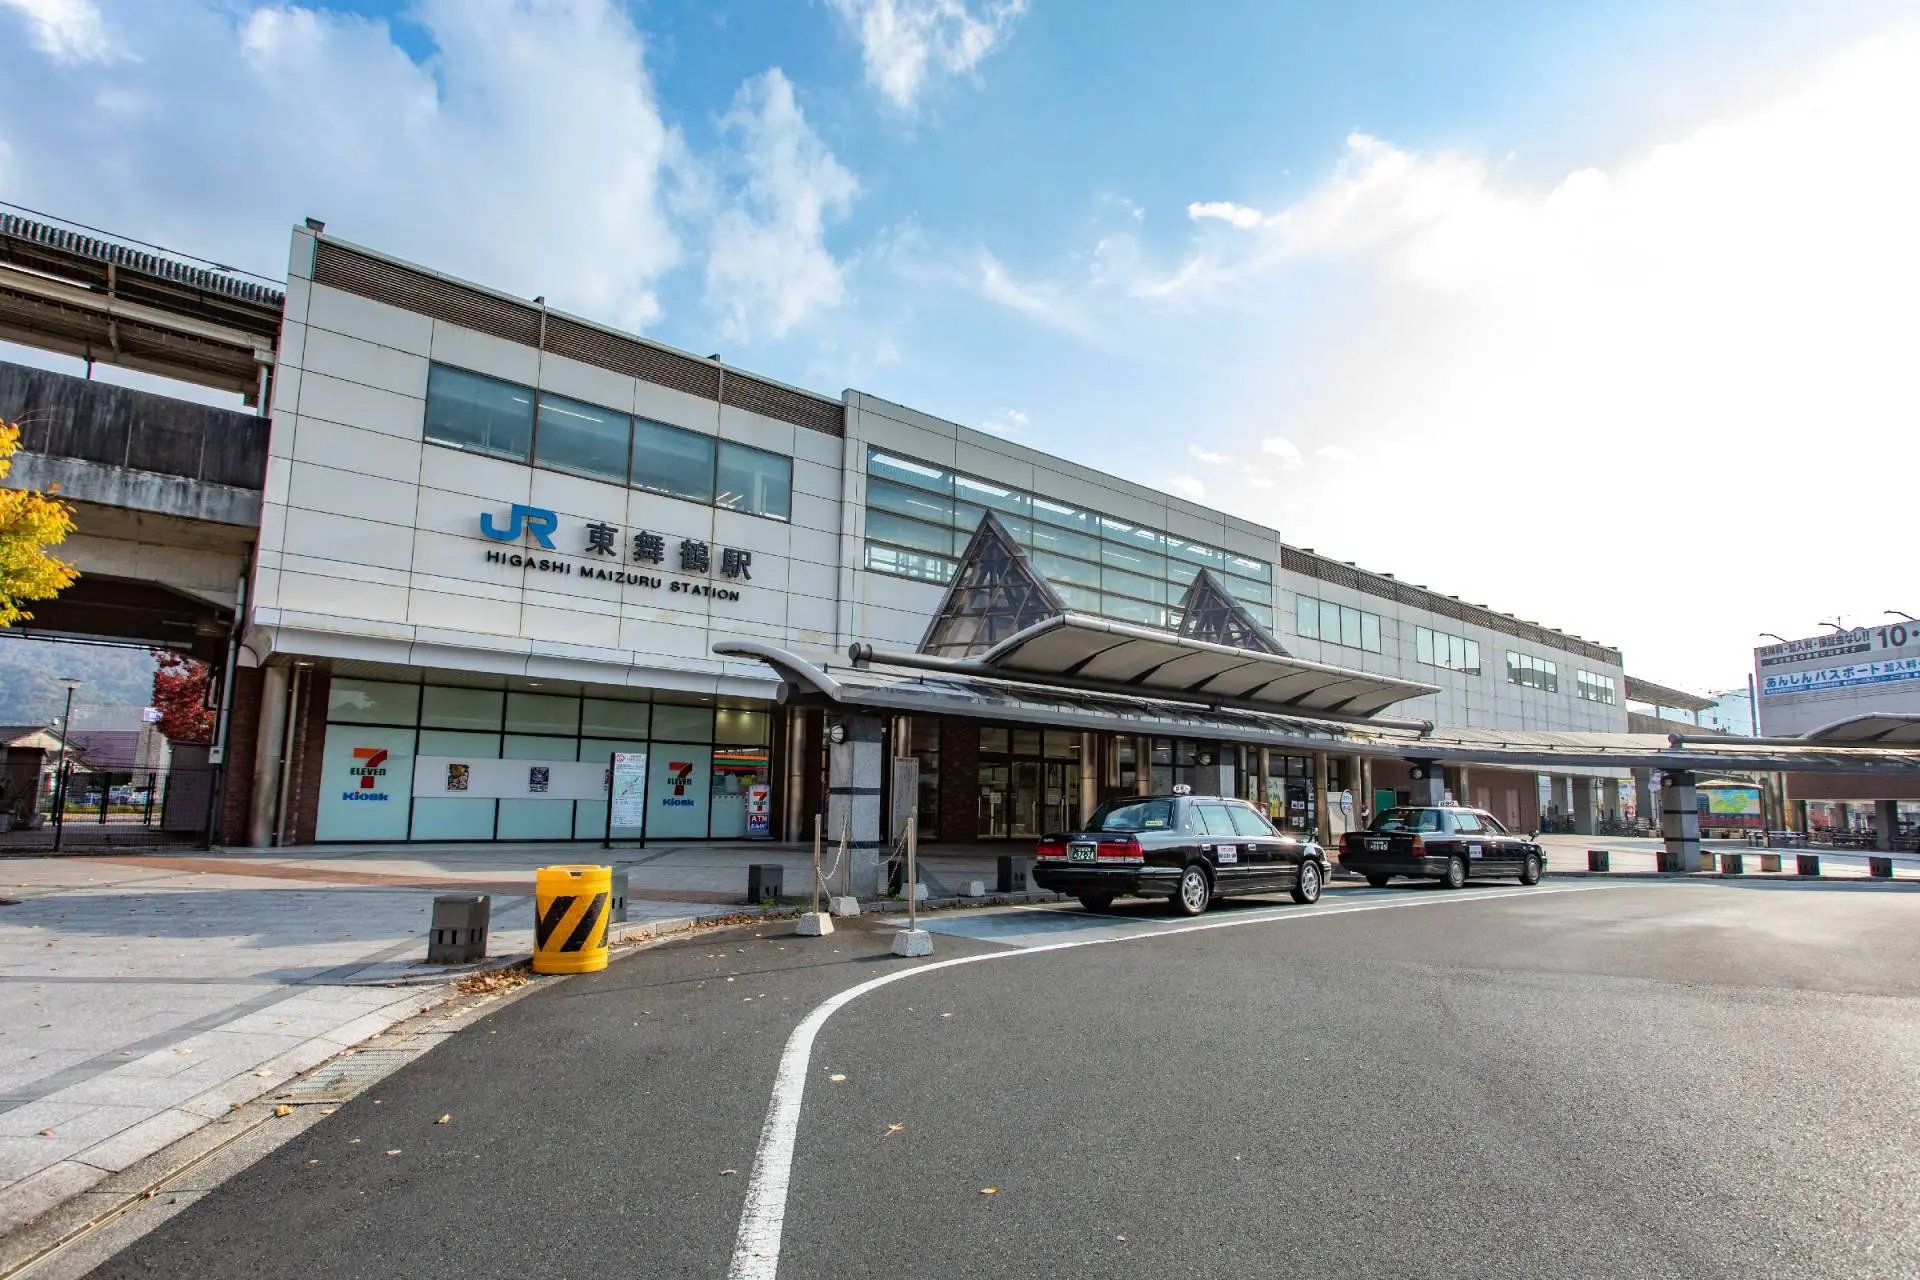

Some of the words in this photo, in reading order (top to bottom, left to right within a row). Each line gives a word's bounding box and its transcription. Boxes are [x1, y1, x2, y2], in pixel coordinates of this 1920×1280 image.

[480, 503, 558, 549] JR
[584, 522, 753, 581] 東舞鶴駅
[487, 550, 571, 574] HIGASHI
[580, 565, 662, 588] MAIZURU
[669, 581, 740, 602] STATION
[352, 747, 388, 789] 7
[669, 761, 693, 796] 7
[342, 790, 389, 801] Kiosk
